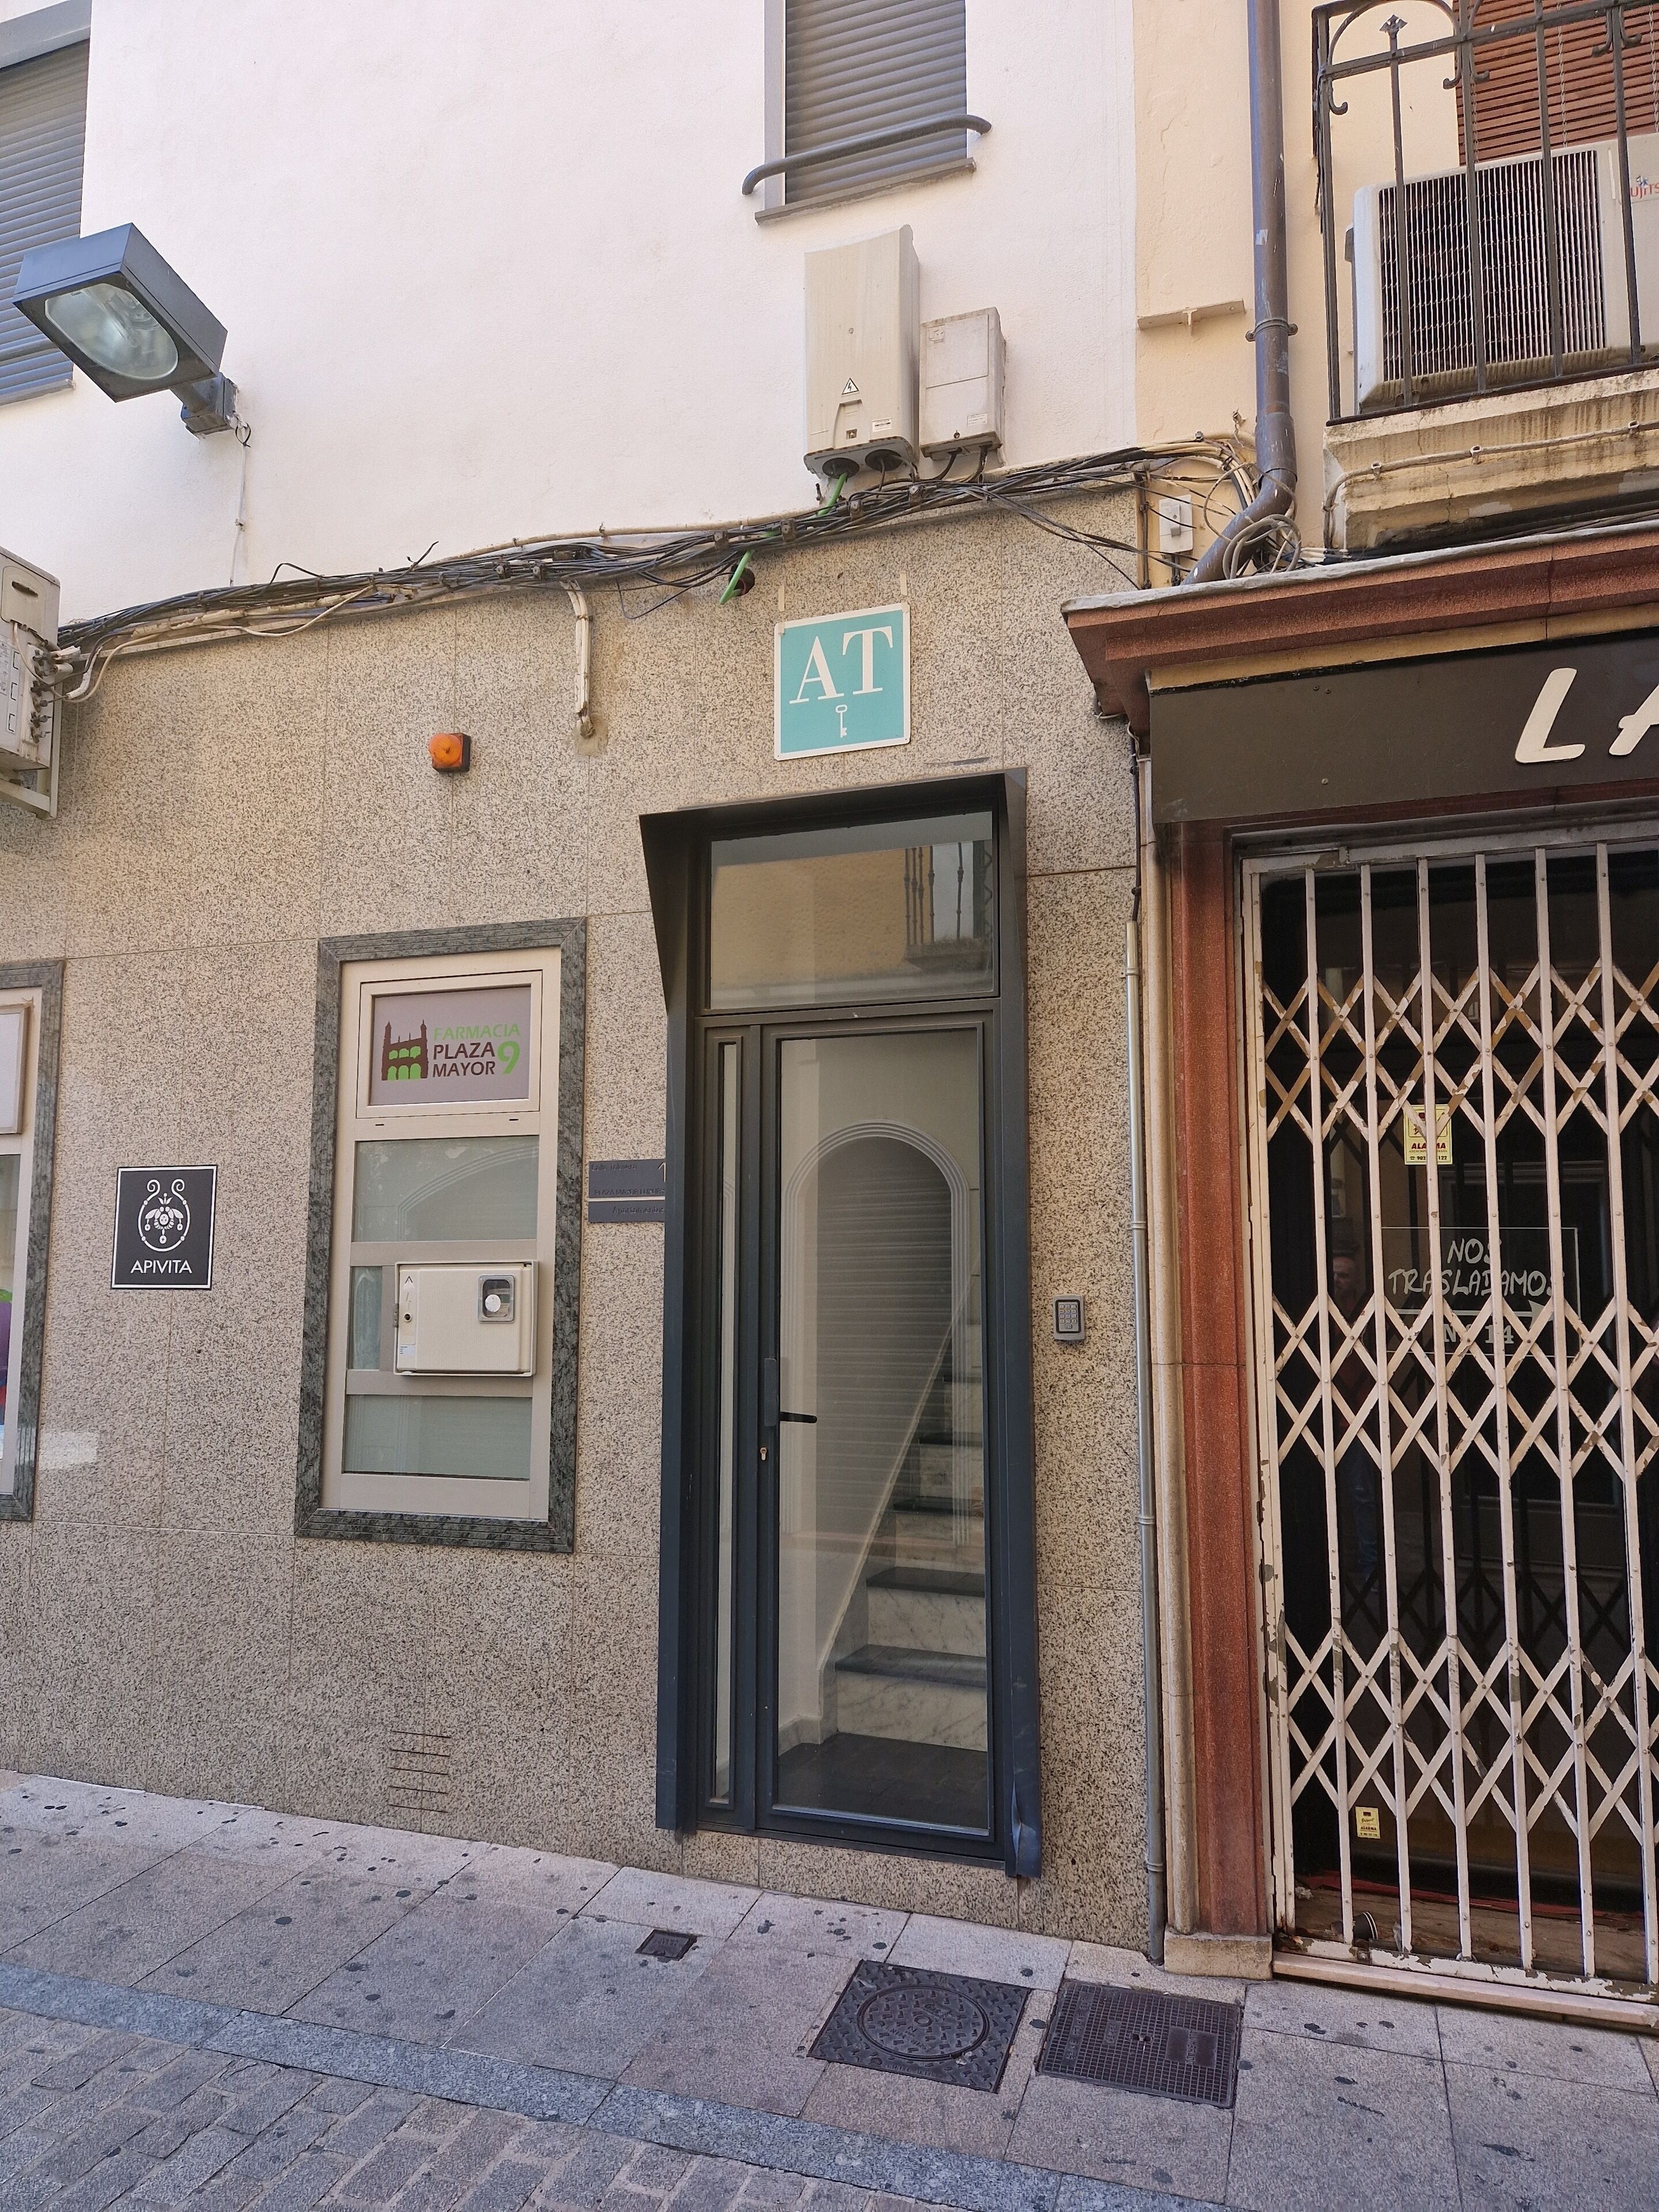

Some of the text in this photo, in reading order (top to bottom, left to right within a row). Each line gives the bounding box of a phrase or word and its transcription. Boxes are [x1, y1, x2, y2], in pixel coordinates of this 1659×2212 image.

[1631, 183, 1659, 199] UJITS
[789, 626, 893, 704] AT
[434, 1023, 520, 1040] FARMACIA
[433, 1041, 495, 1060] PLAZA
[497, 1040, 520, 1075] 9
[433, 1061, 495, 1077] MAYOR
[130, 1259, 192, 1274] APIVITA
